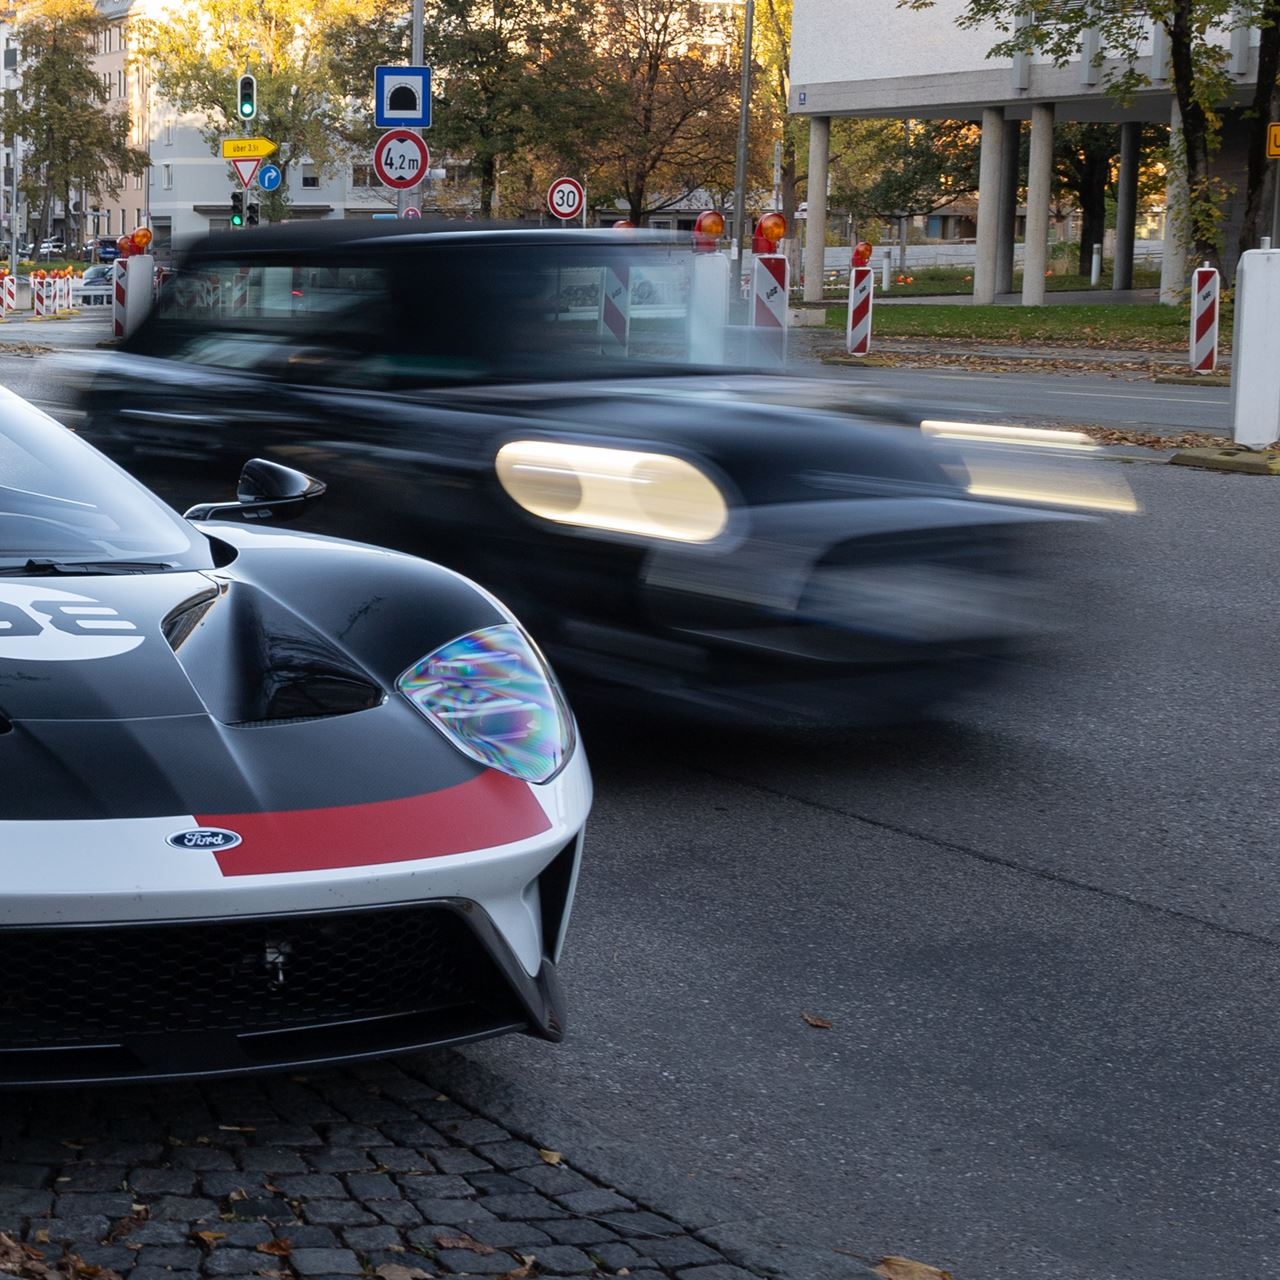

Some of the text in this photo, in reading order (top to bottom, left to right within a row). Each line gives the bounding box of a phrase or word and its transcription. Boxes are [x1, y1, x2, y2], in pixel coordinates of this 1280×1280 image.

[232, 143, 246, 153] über
[408, 158, 419, 170] m
[556, 189, 576, 208] 30
[184, 831, 225, 846] Ford
